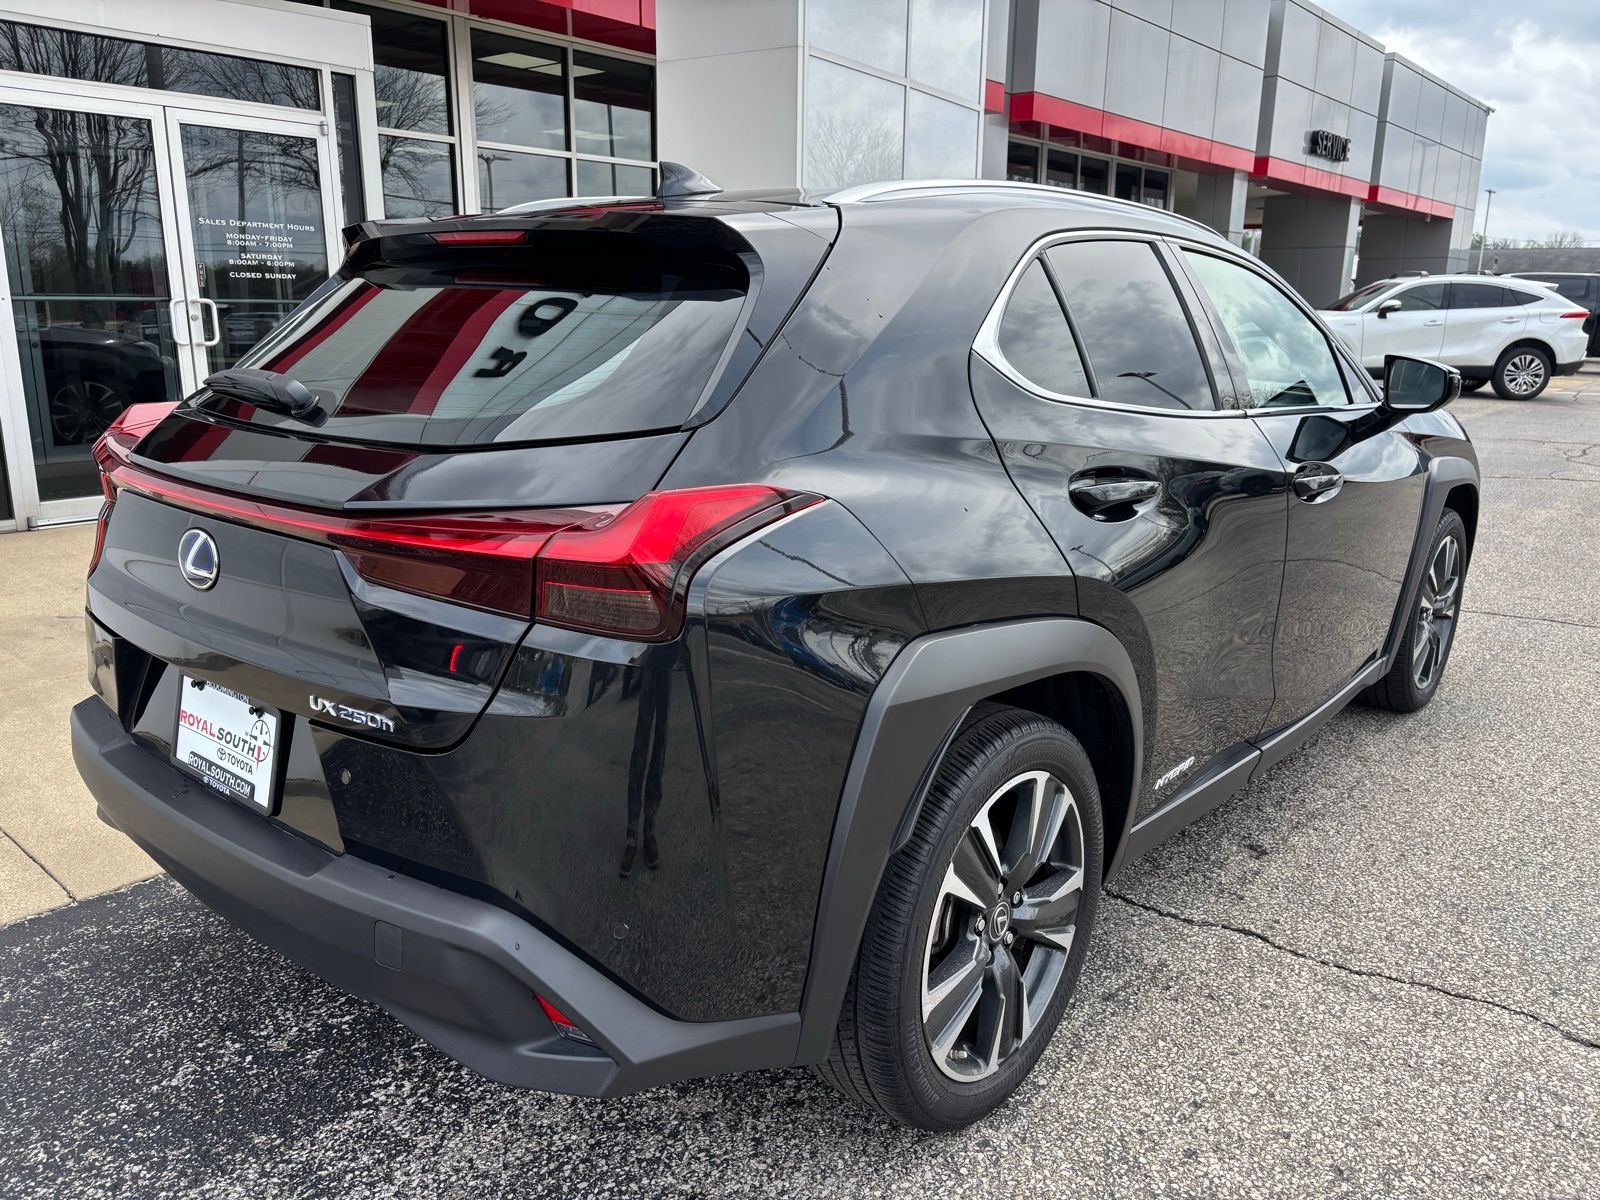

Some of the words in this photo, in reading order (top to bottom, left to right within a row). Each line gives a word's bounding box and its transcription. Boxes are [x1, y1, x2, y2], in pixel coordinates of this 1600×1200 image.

[1310, 129, 1351, 162] SERVICE
[226, 233, 293, 243] MONDAY-FRIDAY
[226, 239, 257, 247] 8:00AM
[265, 241, 294, 249] 7:00PM
[266, 260, 295, 268] 6:00PM
[229, 271, 262, 279] CLOSED
[264, 272, 297, 280] SUNDAY
[309, 694, 337, 717] UX
[180, 708, 216, 738] ROYAL
[216, 727, 257, 759] SOUTH
[226, 752, 253, 776] TOYOTA
[188, 753, 251, 797] ROYALSOUTH.COM
[209, 778, 231, 796] TOYOTA
